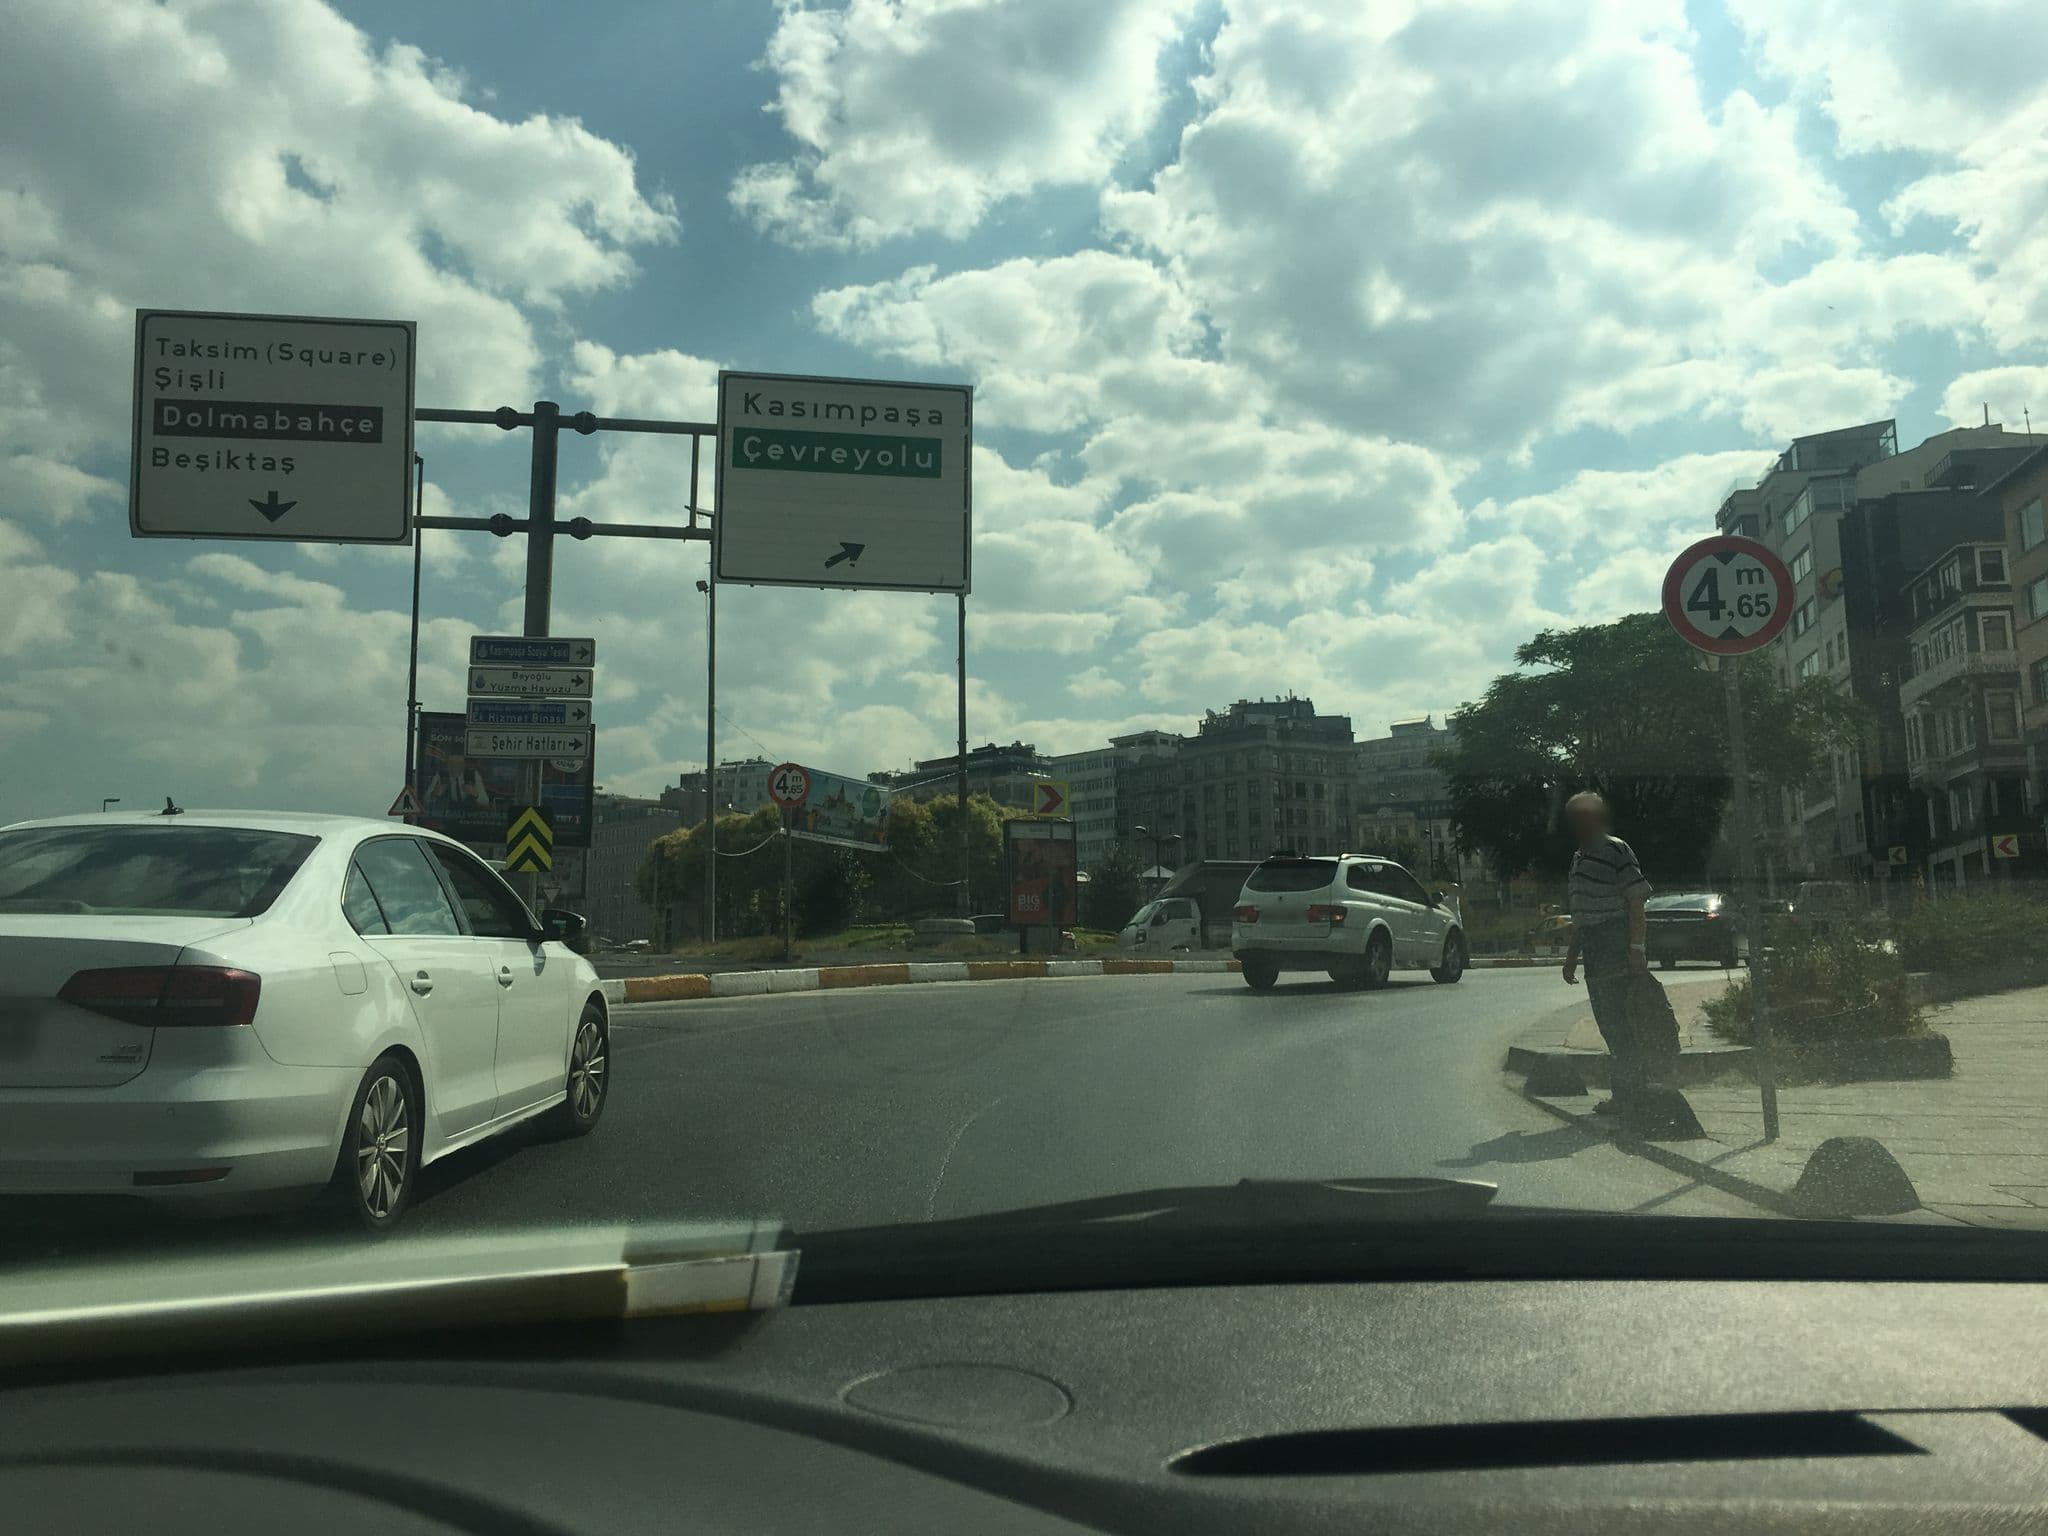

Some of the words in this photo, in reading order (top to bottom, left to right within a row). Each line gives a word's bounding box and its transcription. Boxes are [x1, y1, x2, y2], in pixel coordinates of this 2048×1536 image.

[155, 337, 258, 361] Taksim
[266, 342, 397, 370] (Square)
[154, 366, 226, 392] Şişli
[162, 406, 375, 435] Dolmabahçe
[743, 392, 943, 427] Kasımpaşa
[151, 447, 296, 475] Beşiktaş
[743, 436, 933, 471] Çevreyolu
[491, 735, 523, 752] Şehir
[526, 736, 566, 751] Hatları
[1018, 894, 1040, 905] BIG
